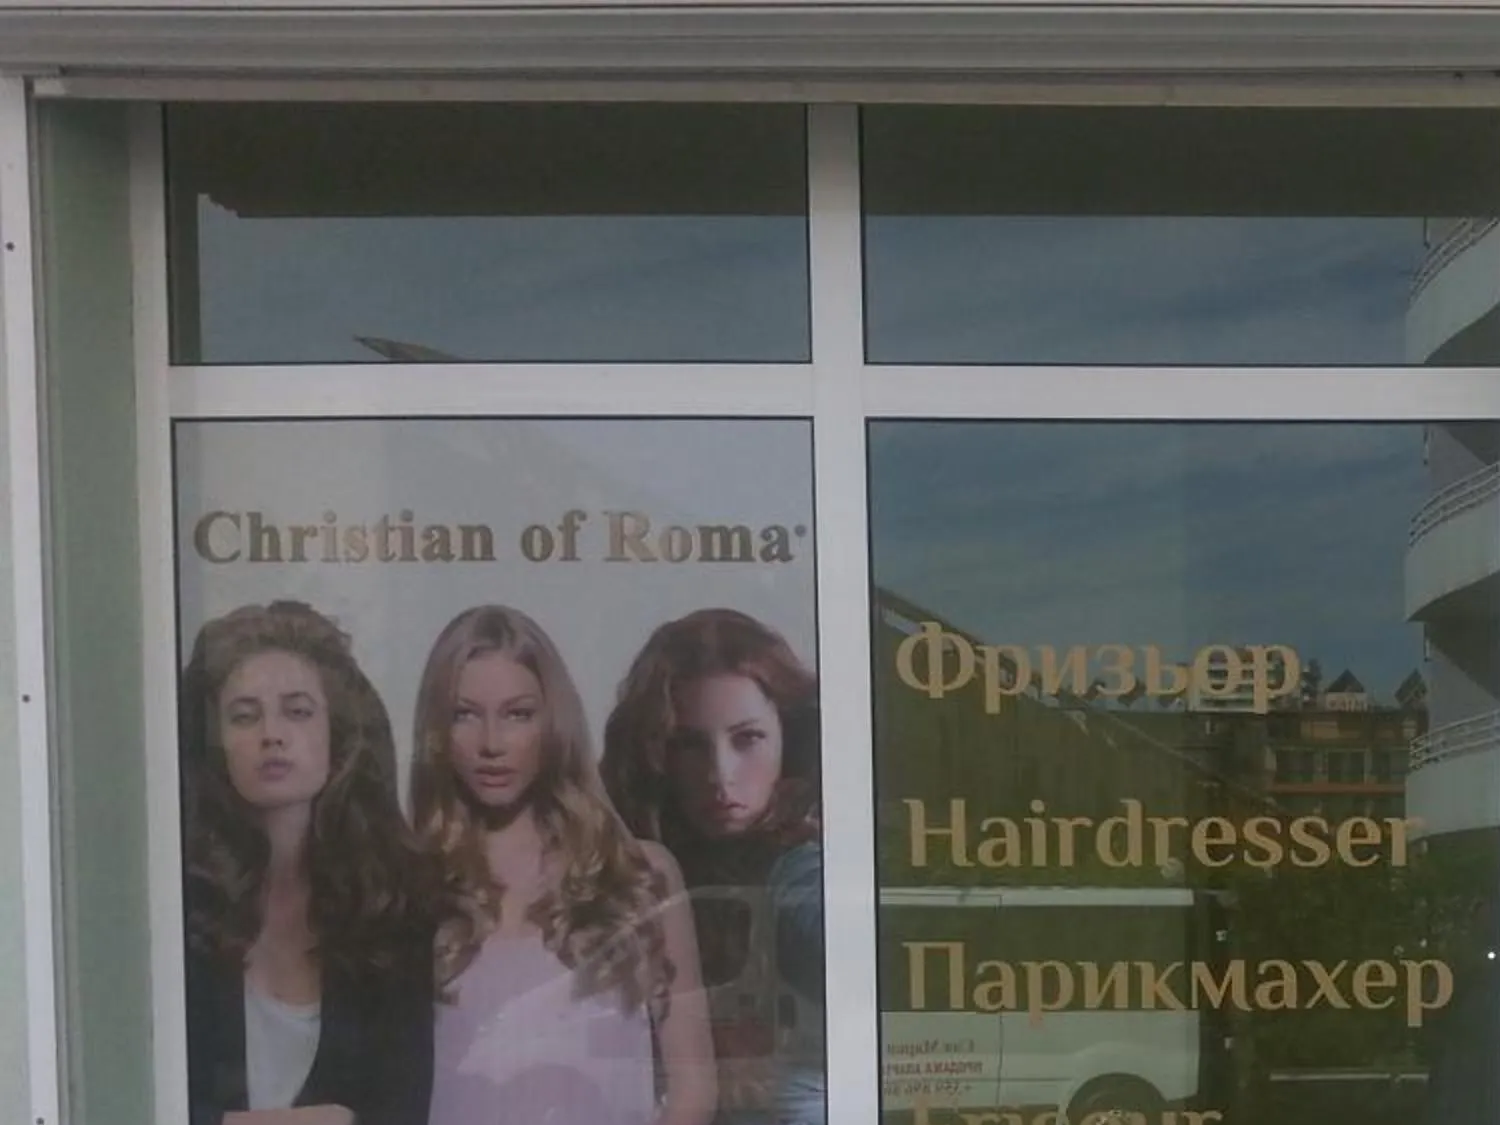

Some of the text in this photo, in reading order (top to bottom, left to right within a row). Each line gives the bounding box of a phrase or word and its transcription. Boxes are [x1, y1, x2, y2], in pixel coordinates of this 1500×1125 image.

[192, 510, 497, 564] Christian
[521, 511, 587, 563] of
[896, 621, 1301, 714] Фризьор
[902, 799, 1422, 868] Hairdresser
[902, 941, 1455, 1027] Парикмахер
